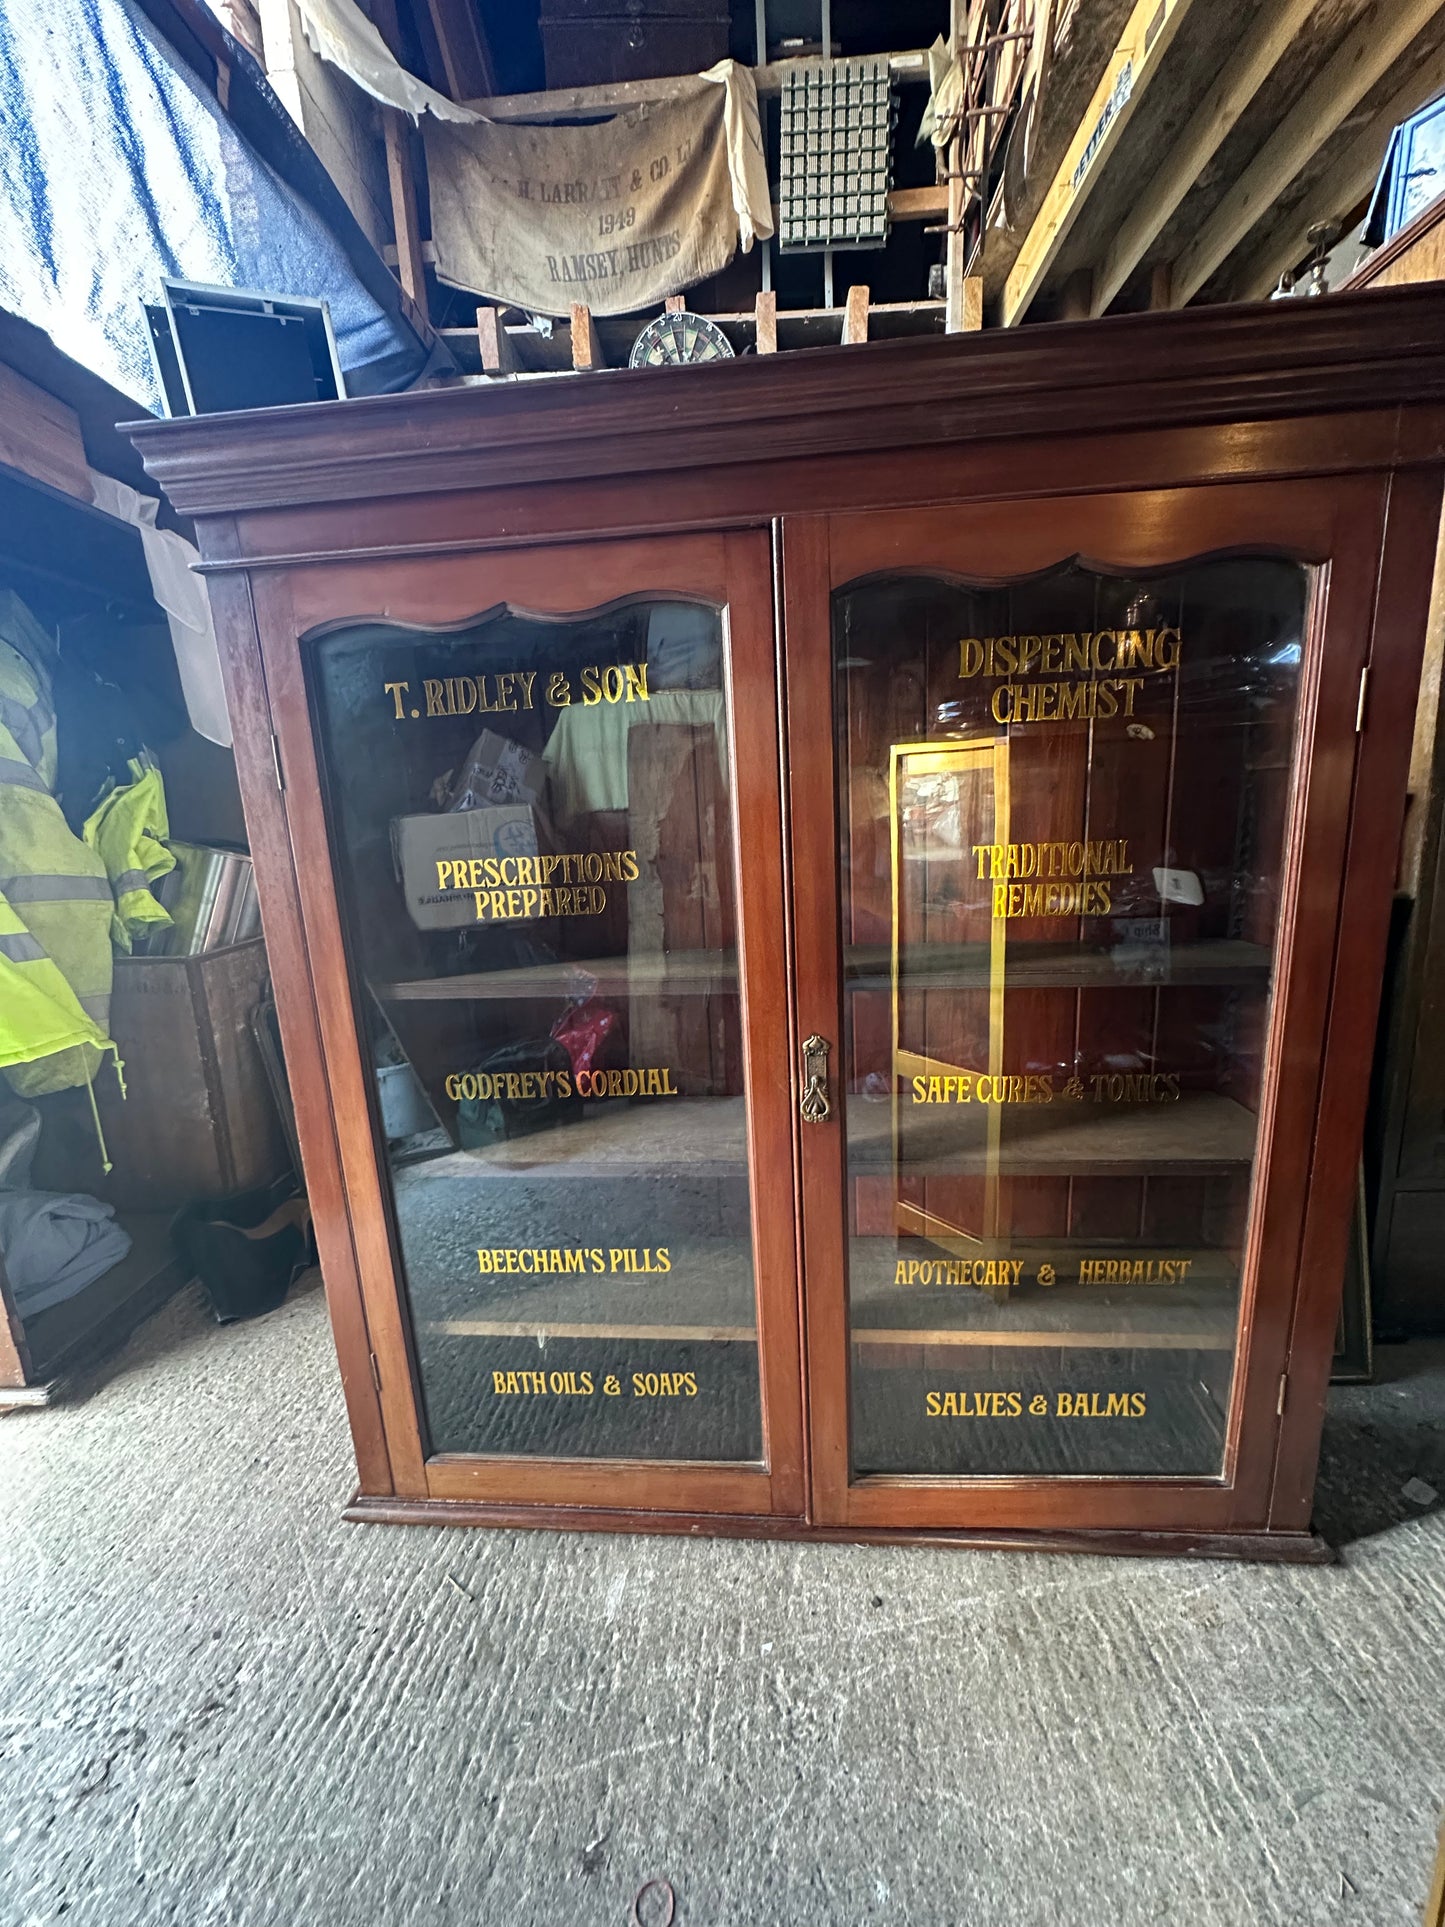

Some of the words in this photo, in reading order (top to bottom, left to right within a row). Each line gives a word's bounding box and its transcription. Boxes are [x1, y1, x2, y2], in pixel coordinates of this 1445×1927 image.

[629, 168, 643, 192] &
[650, 156, 672, 183] CO.
[598, 206, 637, 236] 1949
[547, 249, 624, 282] RAMSEY,
[627, 230, 682, 273] HUNTS
[959, 627, 1182, 678] DISPENCING
[384, 681, 420, 719] T.
[423, 671, 537, 717] RIDLEY
[545, 672, 572, 708] &
[580, 663, 651, 708] SON
[991, 678, 1144, 723] CHEMIST
[435, 850, 640, 890] PRESCRIPTIONS
[972, 840, 1133, 880] TRADITIONAL
[474, 885, 607, 920] PREPARED
[992, 881, 1112, 918] REMEDIES
[445, 1069, 572, 1101] GODFREY'S
[575, 1068, 678, 1098] CORDIAL
[912, 1074, 972, 1104] SAFE
[976, 1073, 1054, 1103] CURES
[1063, 1075, 1085, 1100] &
[1090, 1071, 1181, 1103] TONICS
[477, 1248, 606, 1273] BEECHAM'S
[608, 1247, 672, 1273] PILLS
[894, 1259, 1024, 1286] APOTHECARY
[1037, 1263, 1056, 1286] &
[1078, 1259, 1192, 1285] HERBALIST
[492, 1371, 548, 1395] BATH
[550, 1371, 594, 1395] OILS
[603, 1375, 621, 1396] &
[632, 1371, 698, 1397] SOAPS
[926, 1391, 1022, 1417] SALVES
[1029, 1396, 1048, 1416] &
[1055, 1392, 1147, 1418] BALMS
